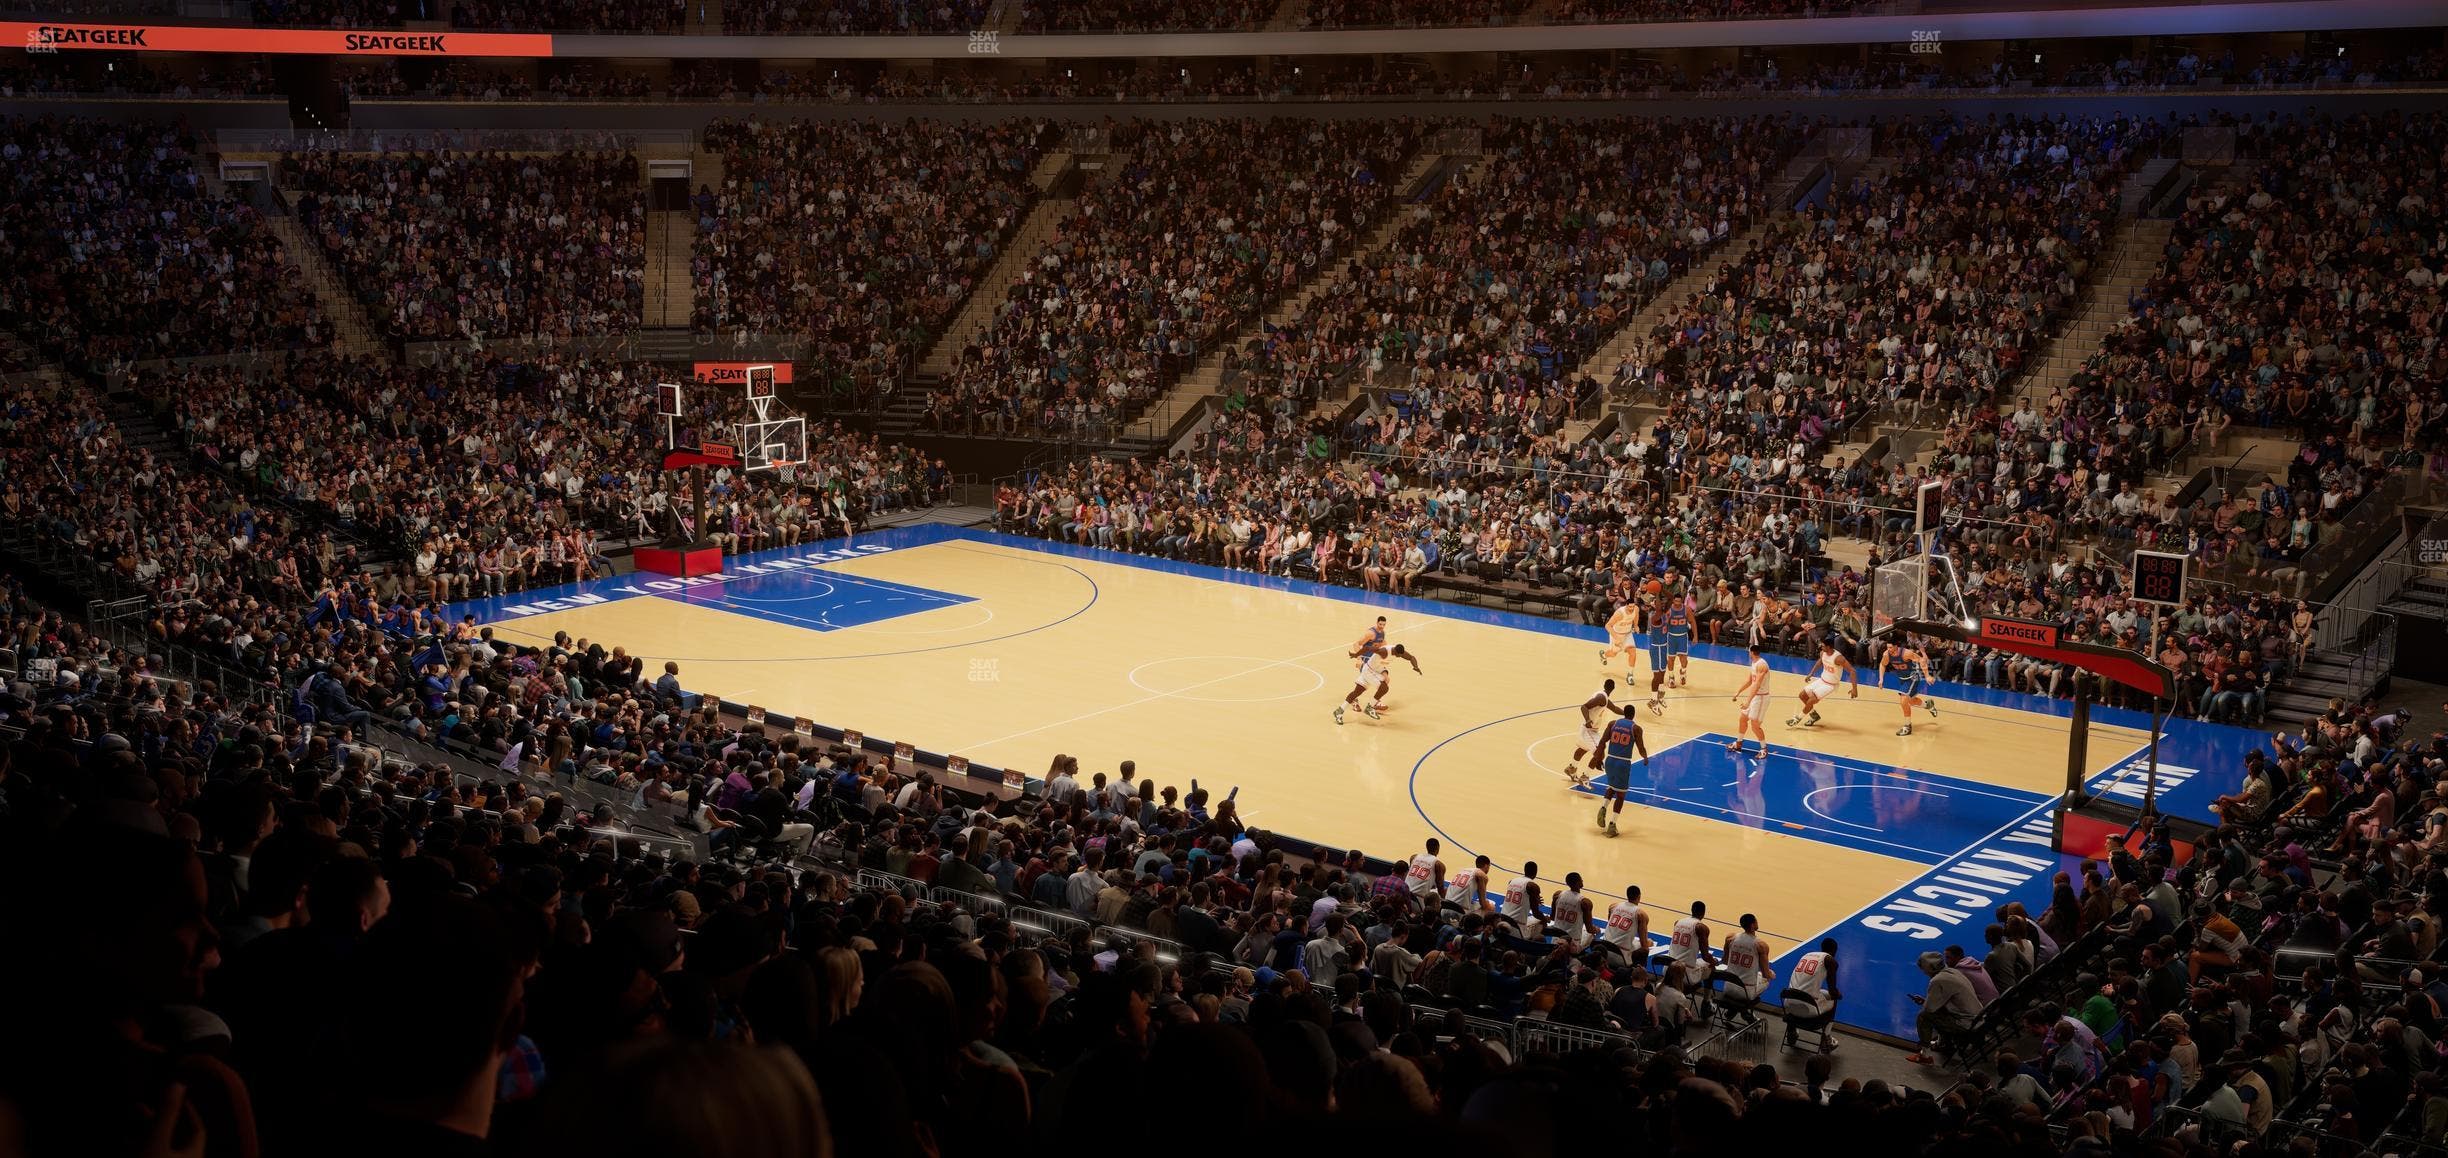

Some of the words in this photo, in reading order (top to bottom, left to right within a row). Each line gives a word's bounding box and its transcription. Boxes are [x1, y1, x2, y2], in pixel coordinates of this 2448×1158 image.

[39, 26, 147, 46] SEATGEEK
[345, 34, 446, 52] SEATGEEK
[502, 592, 609, 618] NEW
[735, 543, 893, 574] KNICKS
[1990, 623, 2047, 641] SEATGEEK
[1860, 847, 2055, 940] KNICKS
